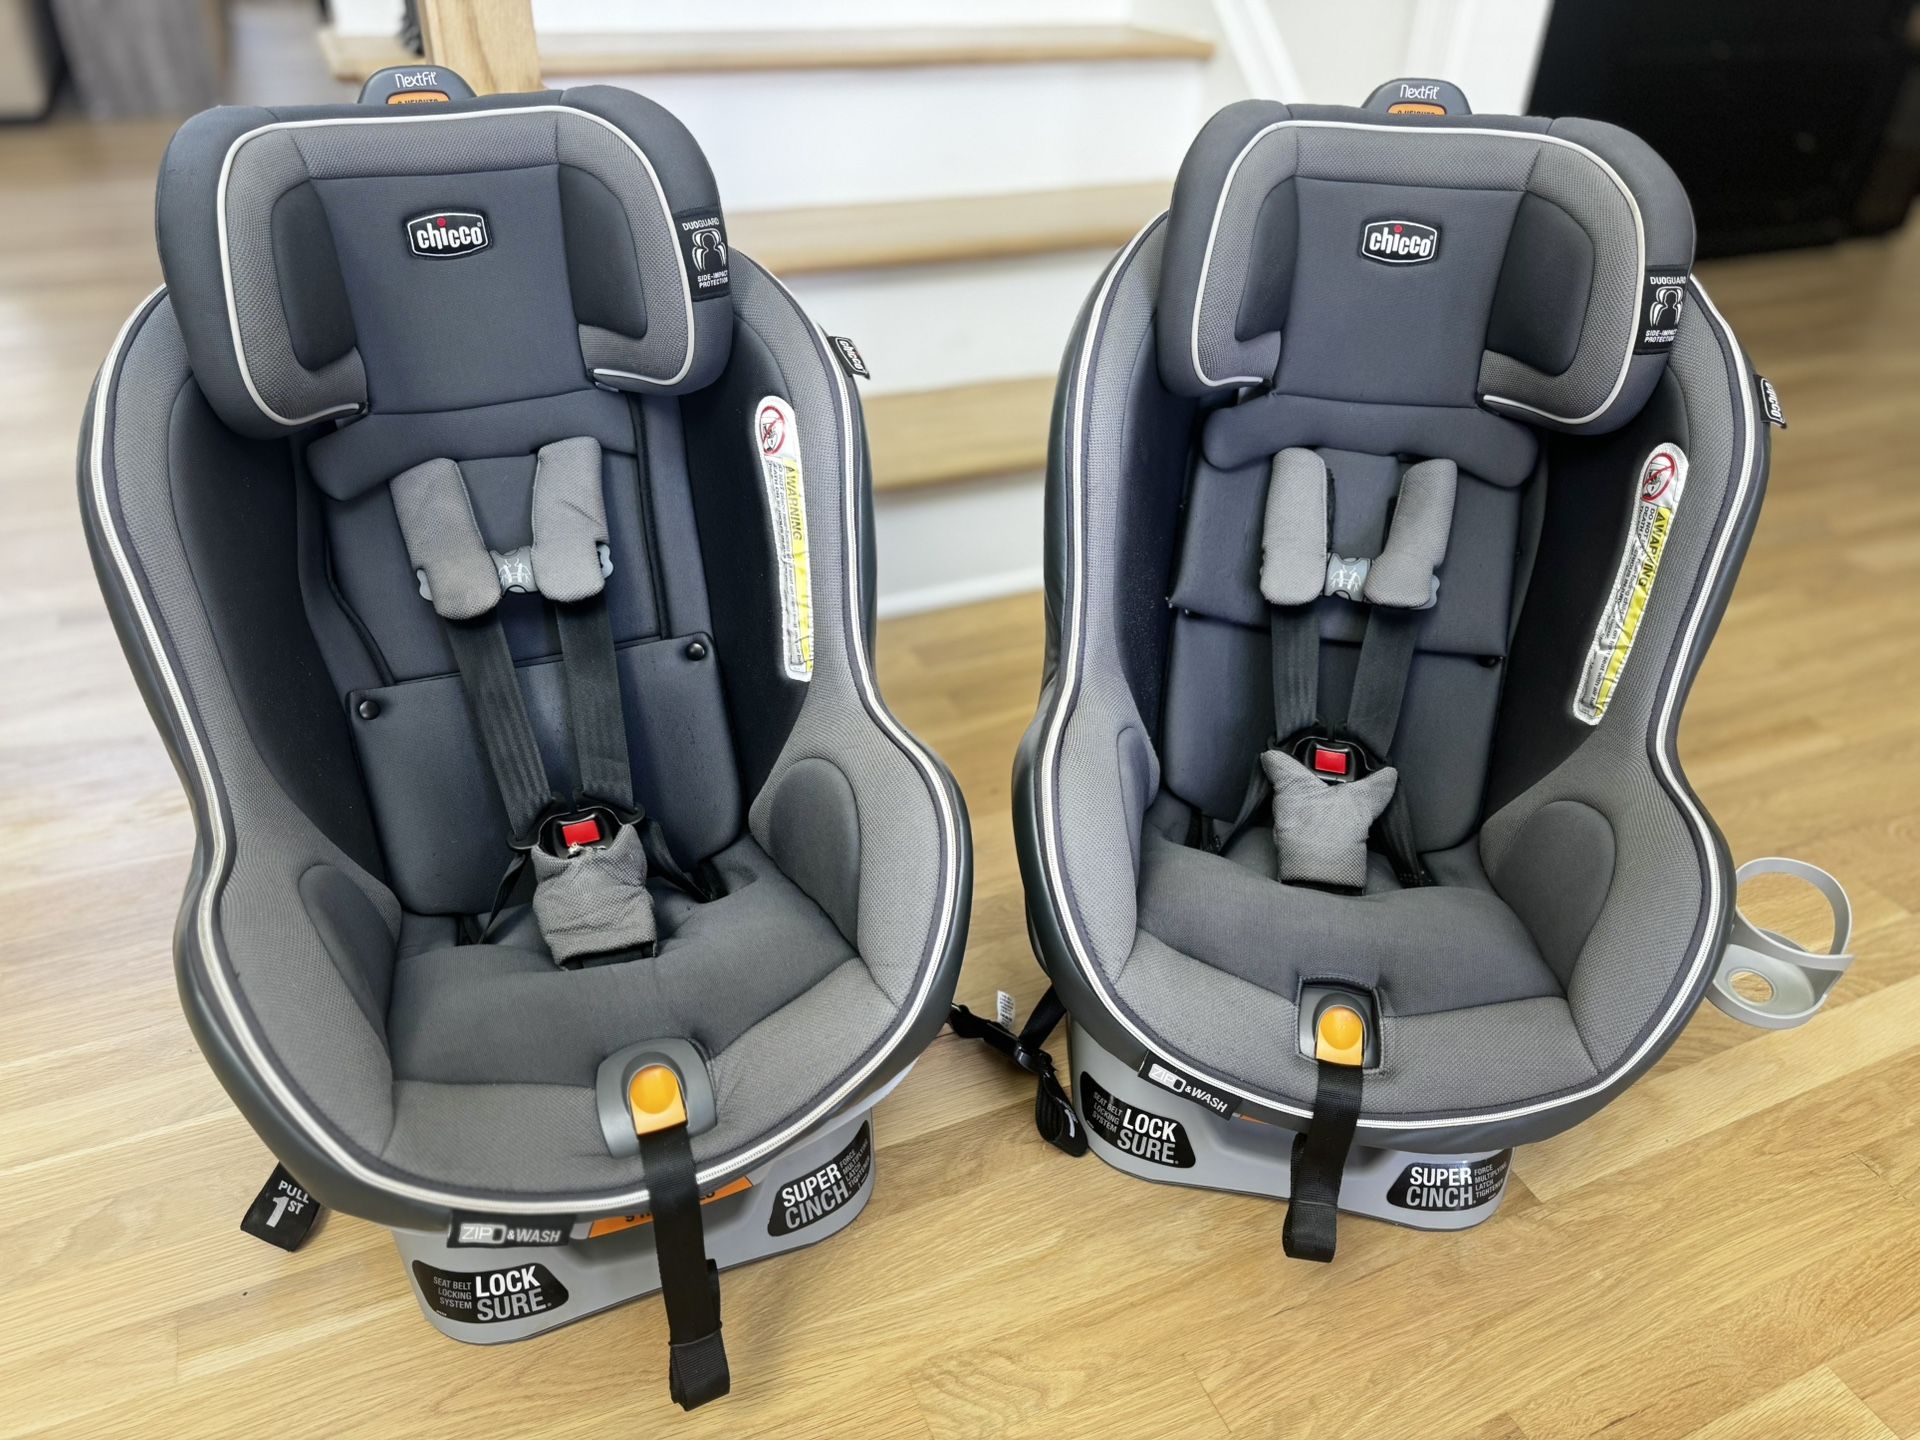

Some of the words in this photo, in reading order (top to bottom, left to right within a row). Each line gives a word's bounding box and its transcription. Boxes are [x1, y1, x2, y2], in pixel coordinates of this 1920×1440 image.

[395, 72, 437, 88] NextFit
[1400, 85, 1439, 99] NextFit
[682, 217, 720, 231] DUOGUARD
[416, 217, 483, 249] chicco
[1369, 225, 1431, 256] chicco
[1650, 276, 1687, 285] DUOGUARD
[786, 475, 802, 541] WARNING
[1122, 1108, 1178, 1143] LOCK
[1409, 1166, 1473, 1187] SUPER
[1474, 1163, 1493, 1176] FORCE
[278, 1180, 309, 1203] PULL
[781, 1163, 842, 1208] SUPER
[1475, 1179, 1494, 1191] LATCH
[434, 1276, 451, 1288] SEAT
[453, 1281, 472, 1290] BELT
[475, 1265, 541, 1297] LOCK
[438, 1288, 472, 1300] LOCKING
[440, 1297, 472, 1309] SYSTEM
